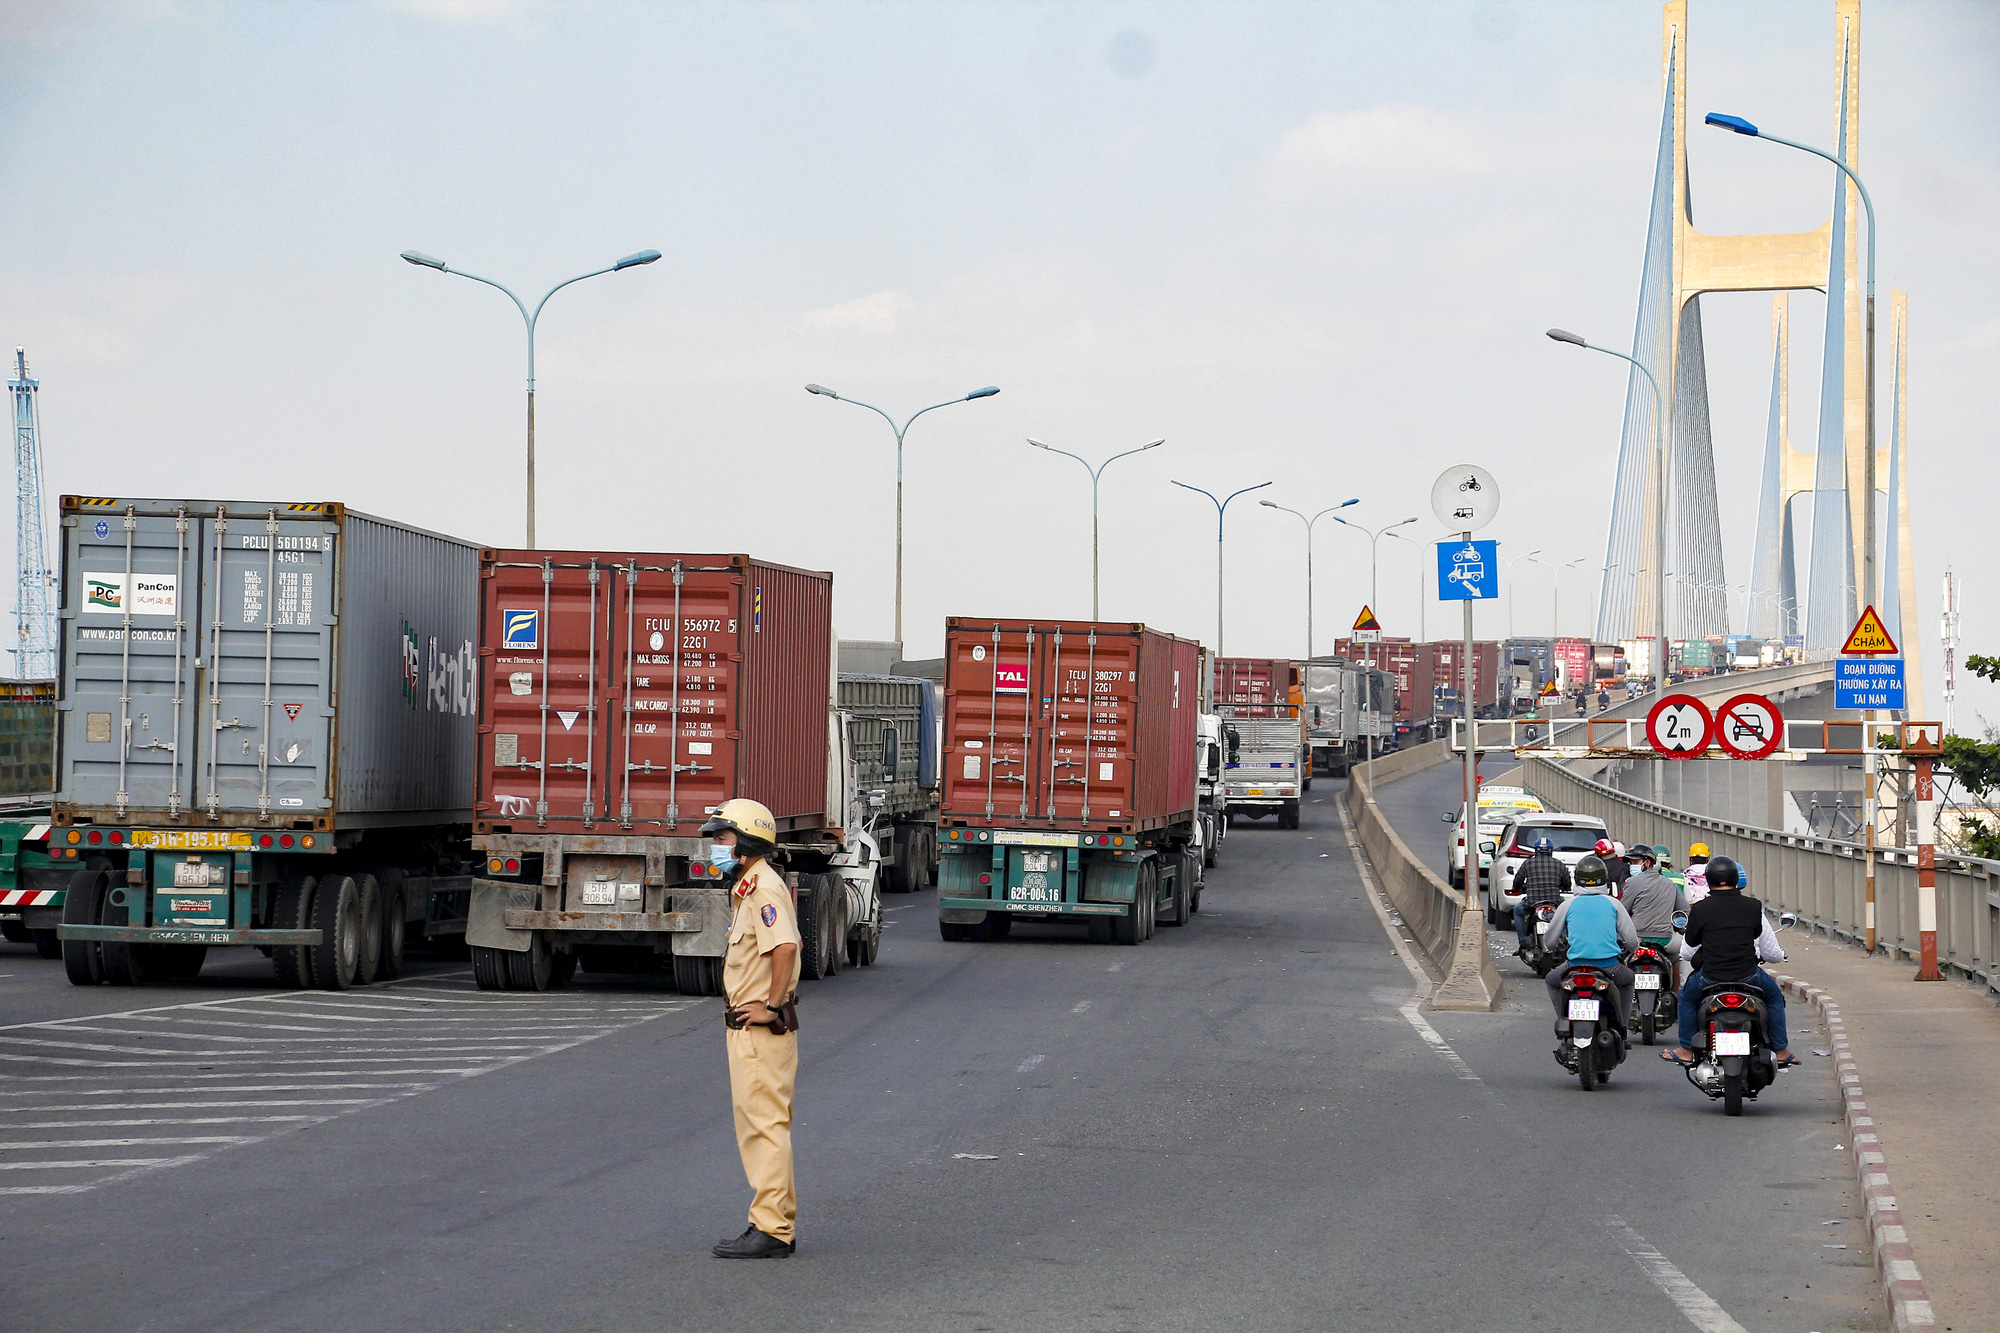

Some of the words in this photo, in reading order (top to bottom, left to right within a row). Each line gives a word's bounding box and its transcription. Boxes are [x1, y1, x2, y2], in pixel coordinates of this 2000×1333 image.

[242, 536, 268, 549] PCLU
[278, 536, 318, 550] 560194
[324, 536, 330, 550] 5
[278, 552, 304, 563] 45G1
[137, 583, 174, 591] PanCon
[96, 586, 114, 601] PC
[646, 618, 670, 631] FCIU
[684, 619, 720, 632] 556972
[729, 619, 736, 632] 5
[1864, 624, 1875, 633] ĐI
[683, 636, 707, 649] 22G1
[1853, 636, 1885, 648] CHẬM
[652, 654, 670, 664] GROSS
[1069, 670, 1087, 680] TCLU
[1095, 671, 1122, 681] 380297
[1844, 664, 1866, 676] ĐOẠN
[636, 677, 650, 687] TARE
[997, 672, 1026, 681] TAL
[1094, 682, 1112, 692] 22G1
[1890, 679, 1902, 689] RA
[1853, 694, 1866, 704] TAI
[1869, 694, 1887, 706] NẠN
[649, 701, 668, 711] CARGO
[644, 724, 657, 734] CAP.
[1667, 715, 1678, 738] 2
[1680, 728, 1691, 738] m
[183, 864, 201, 875] 51R
[591, 883, 608, 893] 51R
[584, 893, 613, 904] 306.94
[1011, 887, 1059, 901] 62R-004.16
[1570, 1011, 1597, 1019] 589.11
